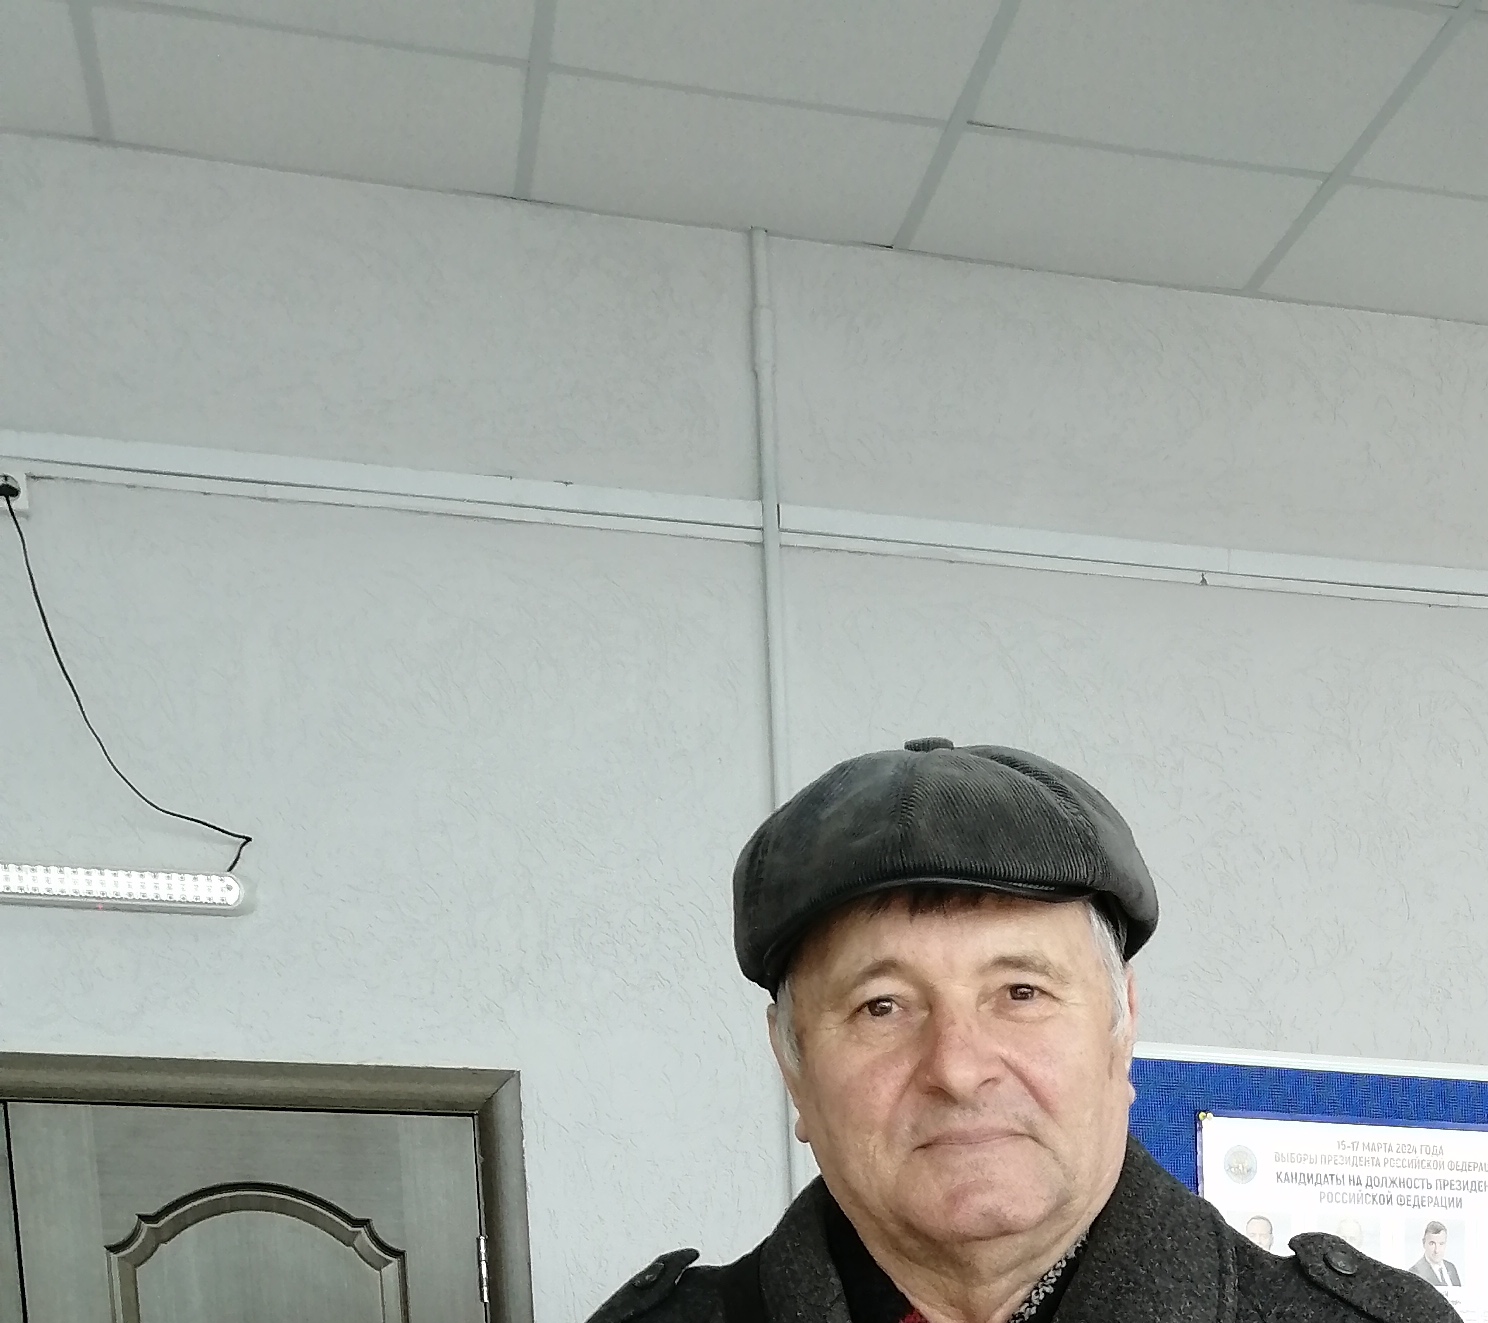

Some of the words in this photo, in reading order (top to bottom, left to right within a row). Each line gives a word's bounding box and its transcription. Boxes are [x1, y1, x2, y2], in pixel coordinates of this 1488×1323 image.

[1362, 1142, 1394, 1153] МАРТА
[1396, 1143, 1417, 1155] 2024
[1419, 1144, 1445, 1157] ГОДА
[1274, 1152, 1318, 1165] ВЫБОРЫ
[1320, 1153, 1381, 1168] ПРЕЗИДЕНТА
[1382, 1156, 1445, 1171] РОССИЙСКОЙ
[1275, 1171, 1346, 1187] КАНДИДАТЫ
[1348, 1174, 1363, 1187] НА
[1365, 1175, 1433, 1191] ДОЛЖНОСТЬ
[1319, 1190, 1394, 1207] РОССИЙСКОЙ
[1396, 1193, 1463, 1210] ФЕДЕРАЦИИ
